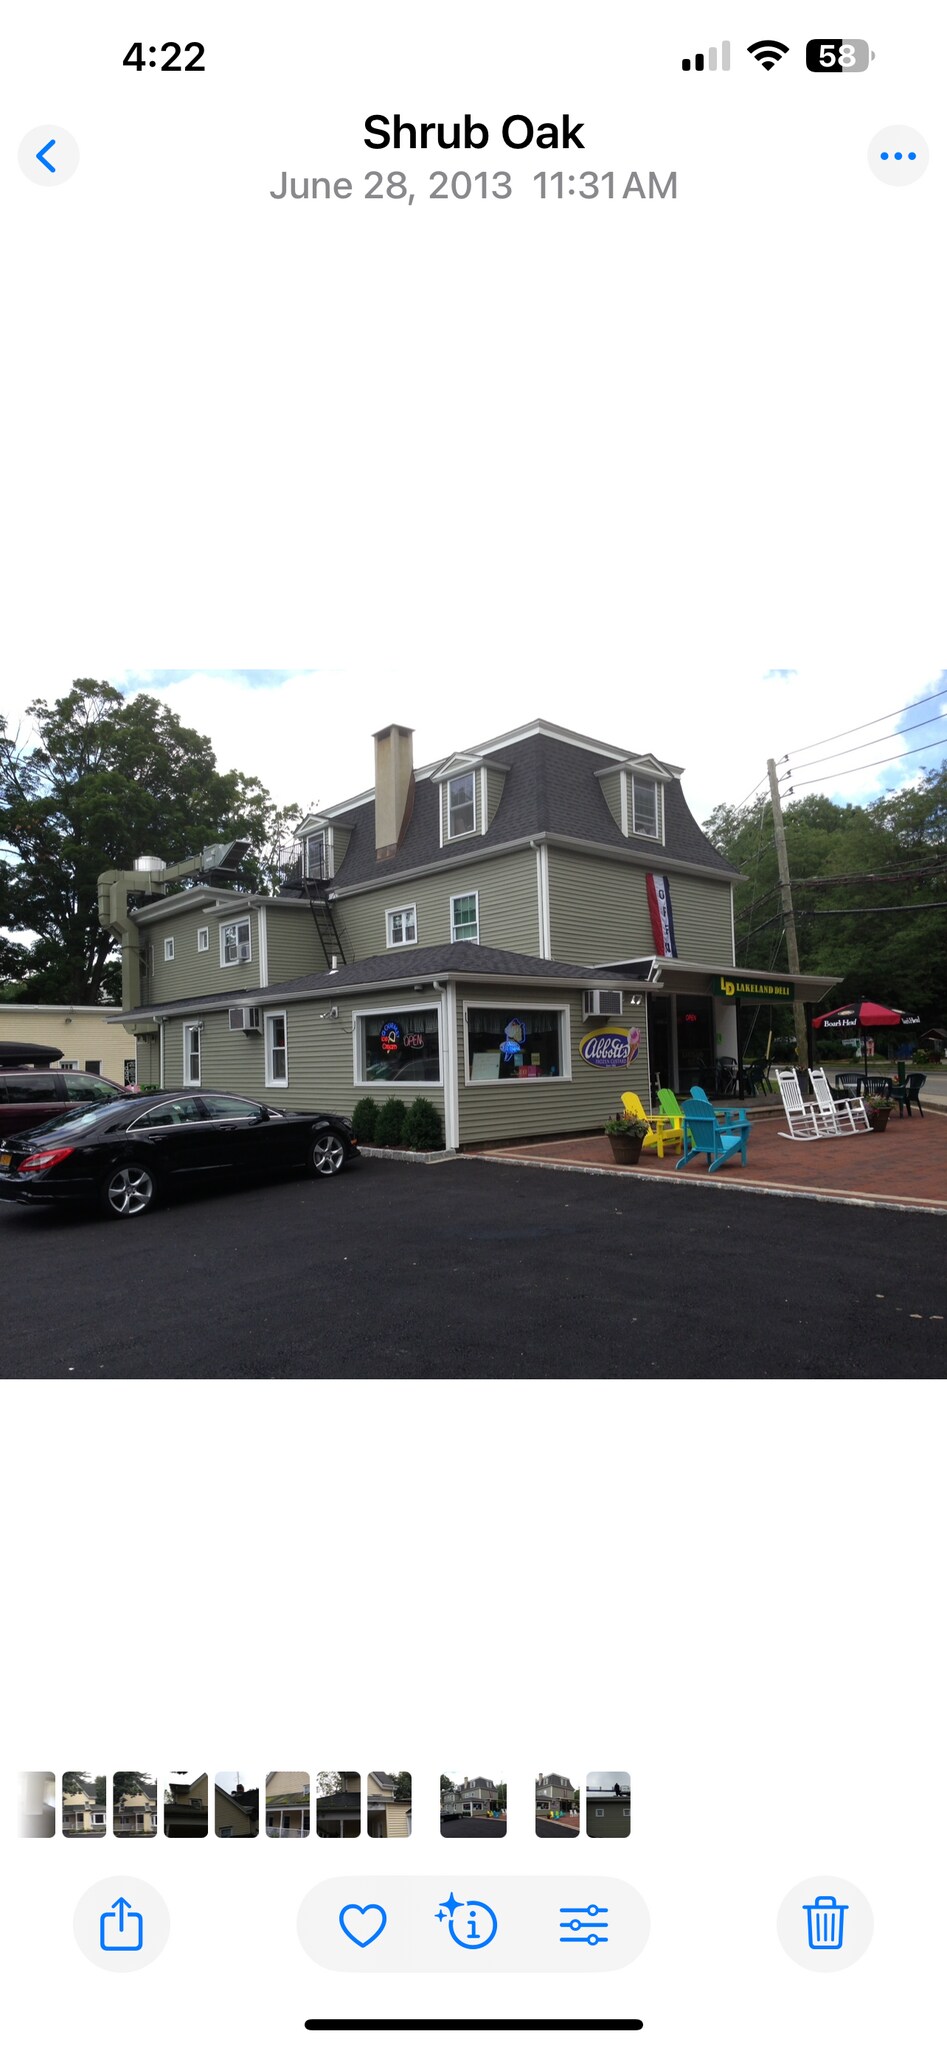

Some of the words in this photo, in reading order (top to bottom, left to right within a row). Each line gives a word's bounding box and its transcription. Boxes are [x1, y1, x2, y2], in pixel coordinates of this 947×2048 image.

[720, 977, 736, 996] LD
[736, 982, 773, 995] LAKELAND
[774, 986, 790, 996] DELI
[403, 1033, 423, 1047] OPEN
